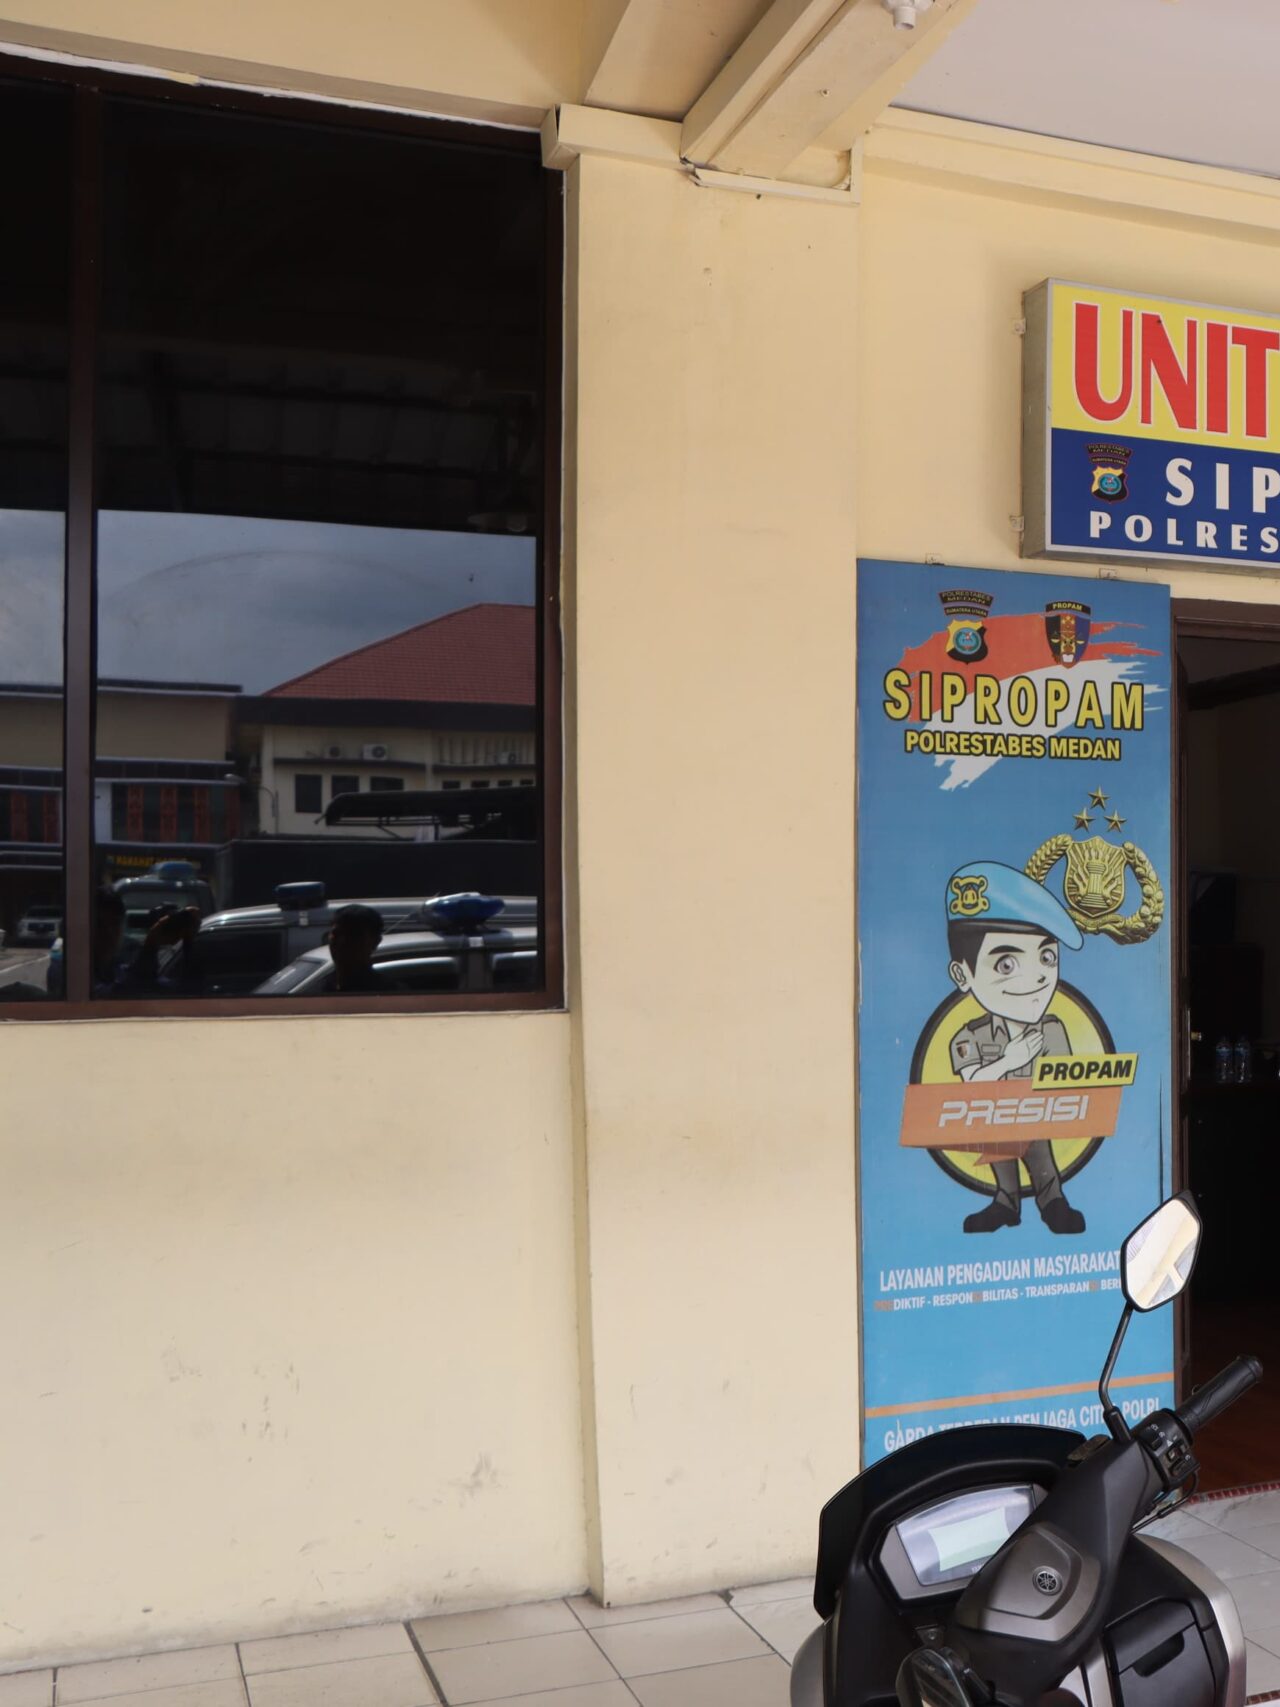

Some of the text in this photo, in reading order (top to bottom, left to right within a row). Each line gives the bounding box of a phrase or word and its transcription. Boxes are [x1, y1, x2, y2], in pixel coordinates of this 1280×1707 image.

[1074, 302, 1280, 438] UNIT
[1052, 602, 1082, 611] PROPAM
[884, 668, 1143, 730] SIPROPAM
[905, 730, 1121, 760] POLRESTABES MEDAN
[1038, 1060, 1133, 1081] PROPAM
[938, 1095, 1089, 1128] PRESISI
[879, 1249, 1121, 1291] LAYANAN PENGADUAN MASYARAKAT
[1025, 1278, 1098, 1298] TRANSPARAN
[1100, 1276, 1121, 1291] BER
[1121, 1397, 1160, 1420] POLRI
